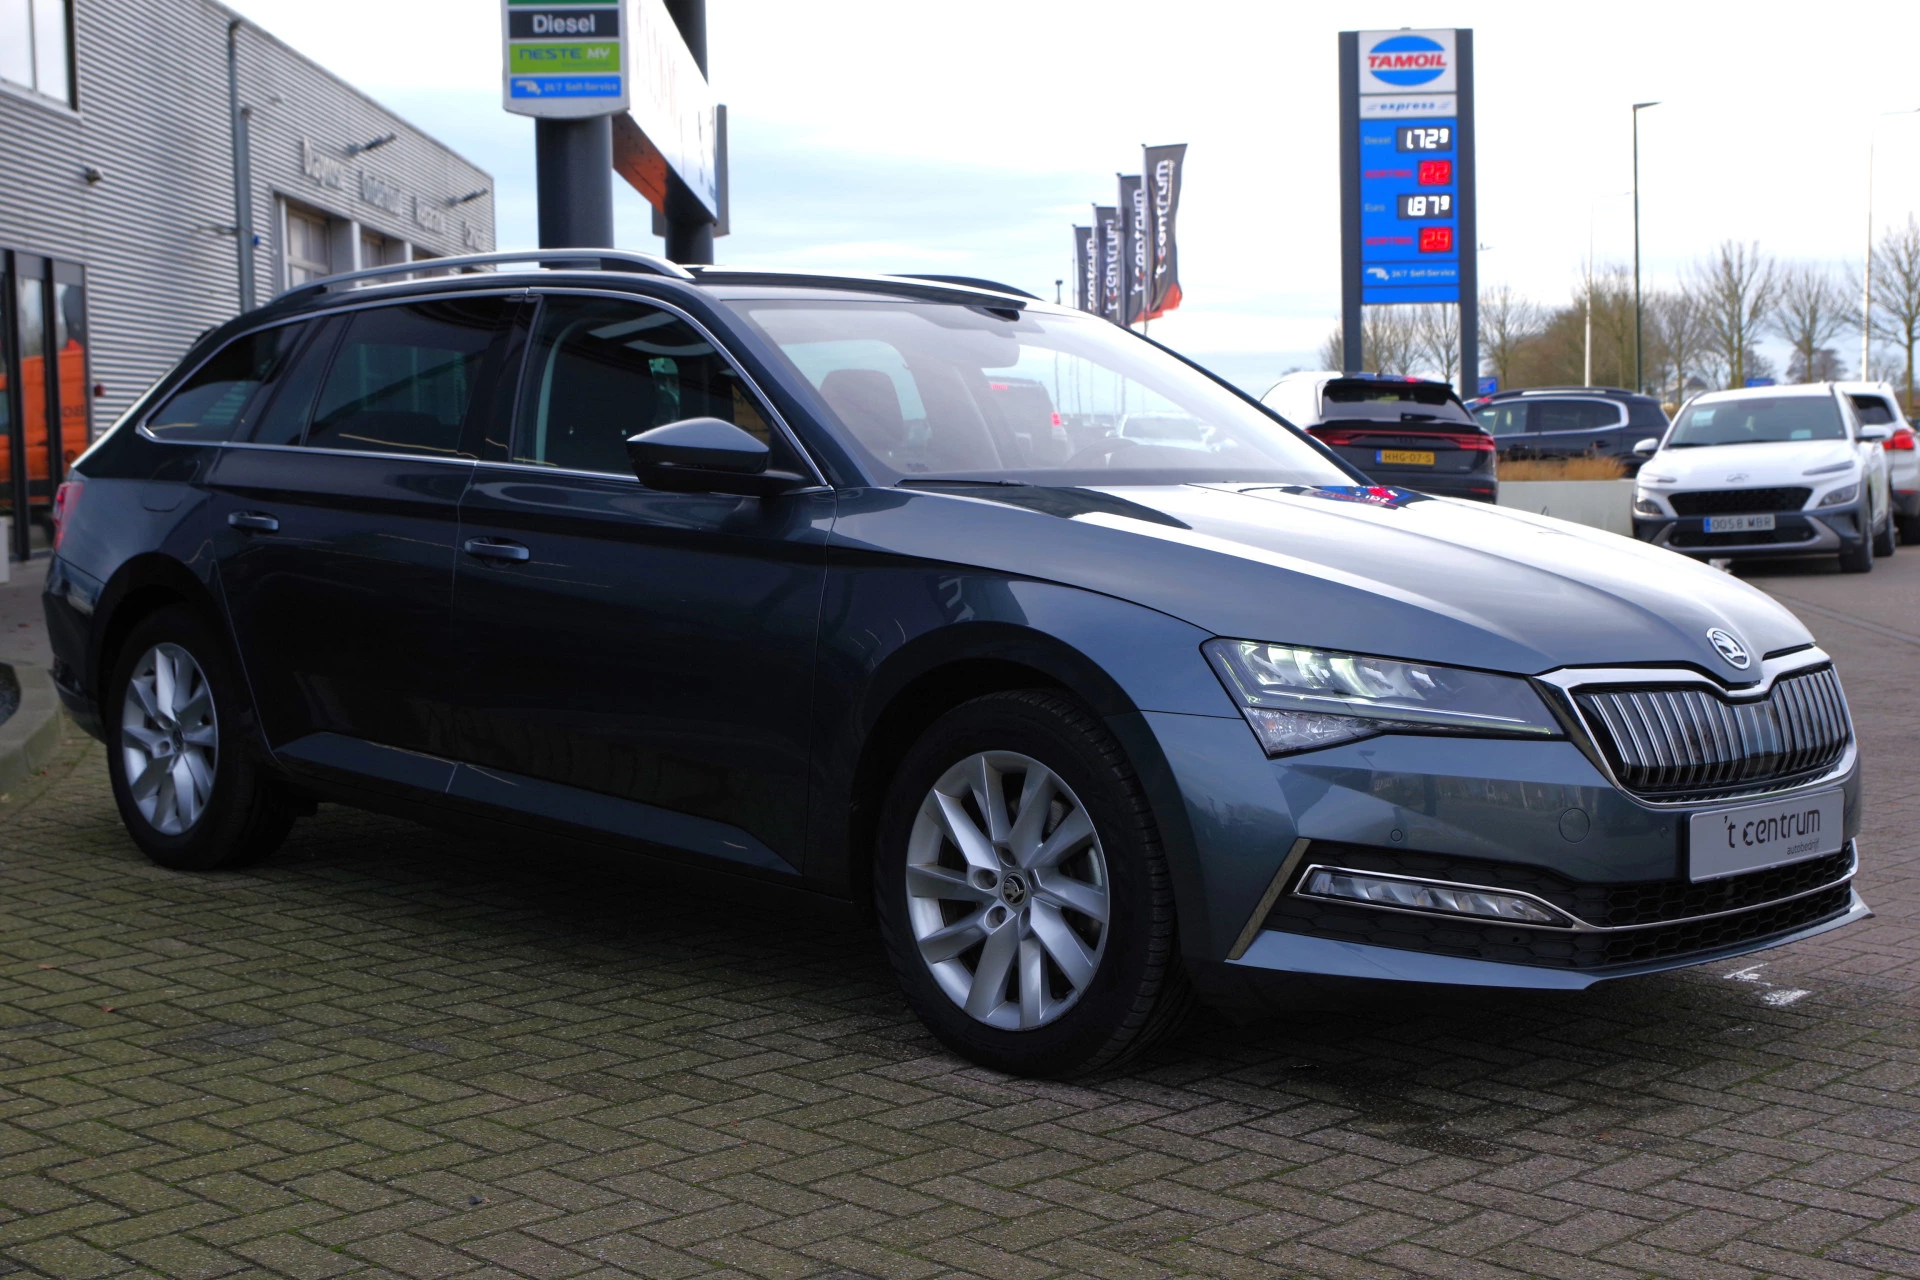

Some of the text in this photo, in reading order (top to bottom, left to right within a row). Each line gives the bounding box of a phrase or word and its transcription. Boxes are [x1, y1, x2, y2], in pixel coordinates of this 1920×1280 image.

[532, 13, 597, 34] Diesel
[519, 46, 611, 61] NESTE MY
[1368, 53, 1448, 69] TAMOIL
[1380, 102, 1436, 112] express
[1724, 809, 1820, 849] 't centrum
[1786, 838, 1820, 856] autobedrijf
